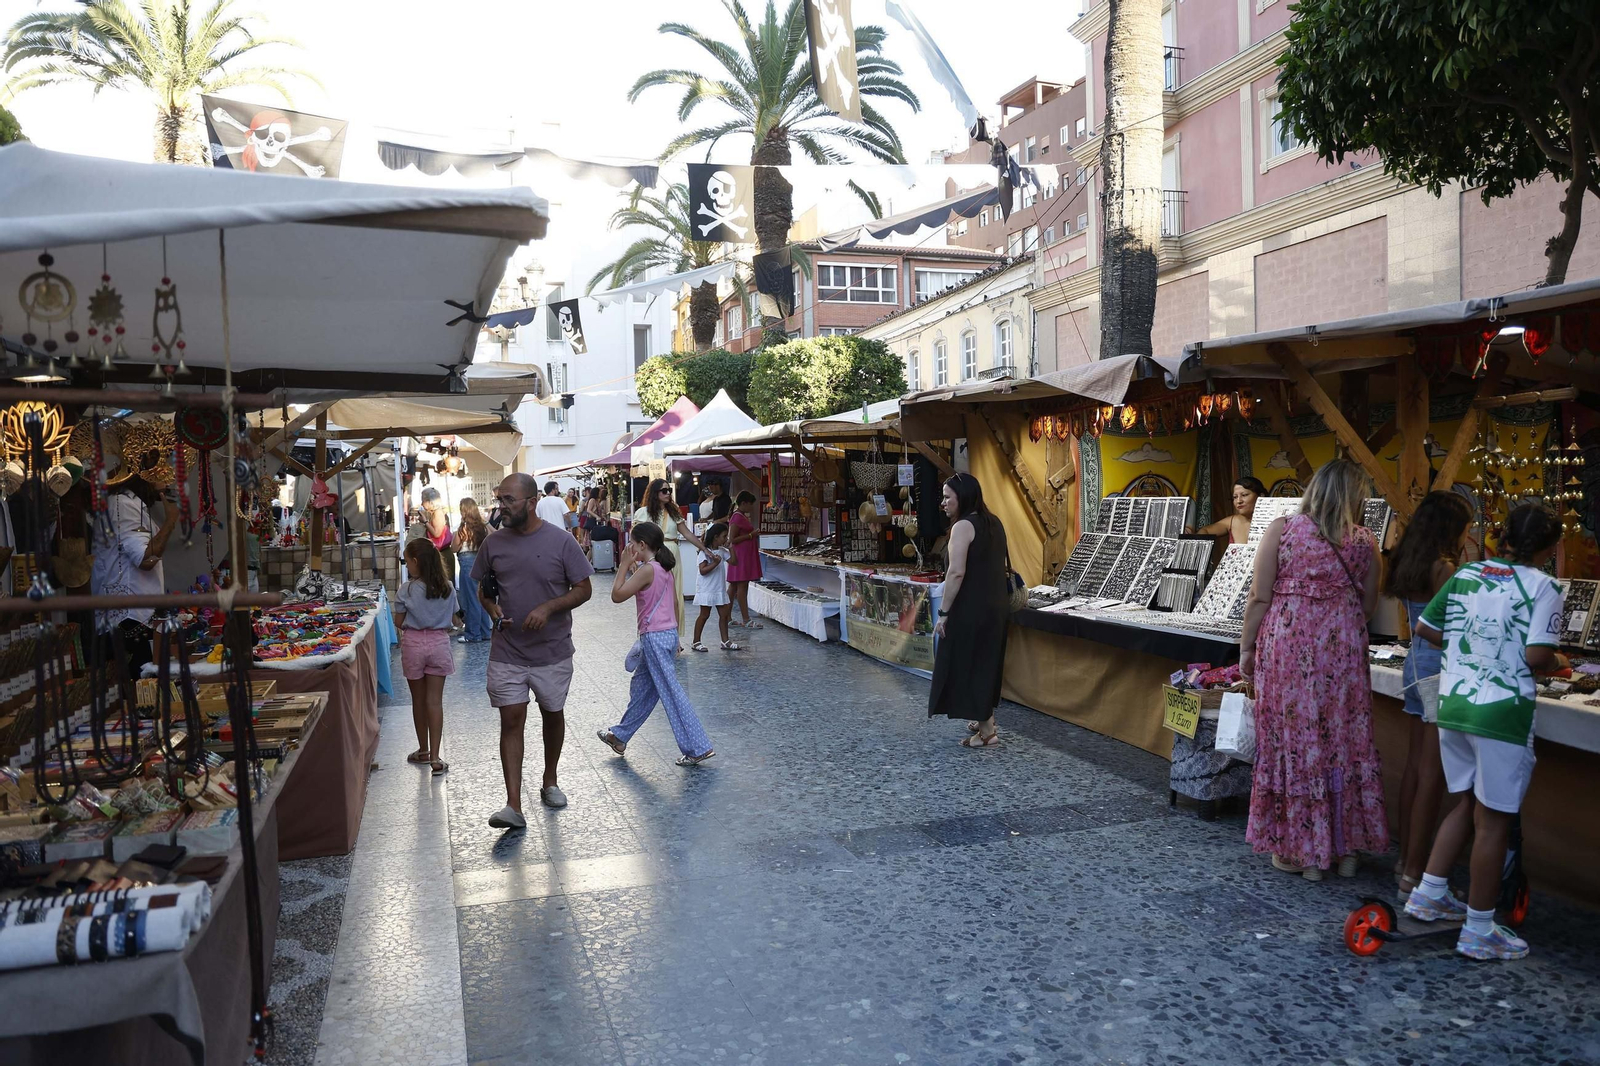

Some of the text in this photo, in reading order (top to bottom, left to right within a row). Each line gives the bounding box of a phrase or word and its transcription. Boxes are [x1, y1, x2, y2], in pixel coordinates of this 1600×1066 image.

[1167, 692, 1198, 715] SORPRESAS
[1170, 711, 1192, 730] 1 Euro
